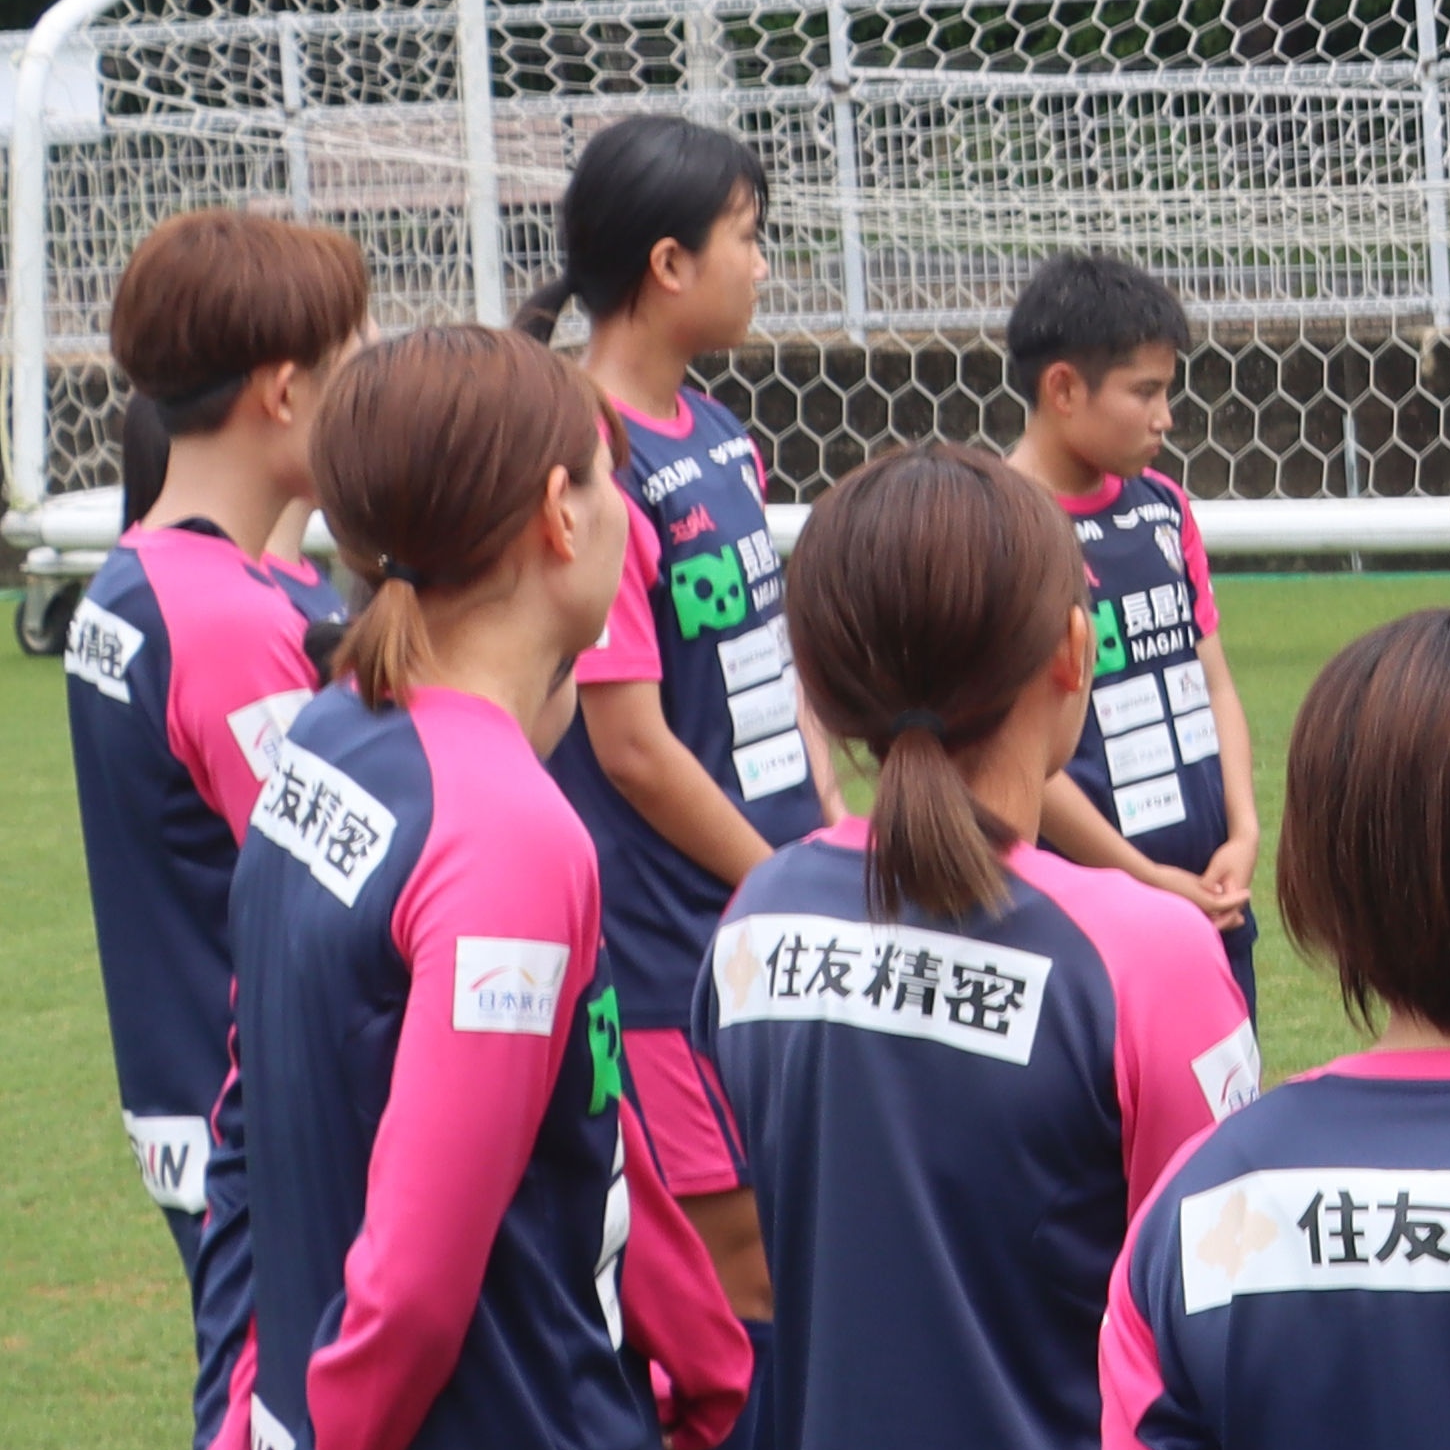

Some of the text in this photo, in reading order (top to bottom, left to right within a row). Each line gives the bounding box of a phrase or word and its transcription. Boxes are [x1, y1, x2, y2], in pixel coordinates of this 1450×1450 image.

[66, 618, 125, 680] 精密
[1130, 627, 1183, 663] NAGAI
[264, 759, 381, 879] 友精密
[766, 932, 1028, 1037] 住友精密
